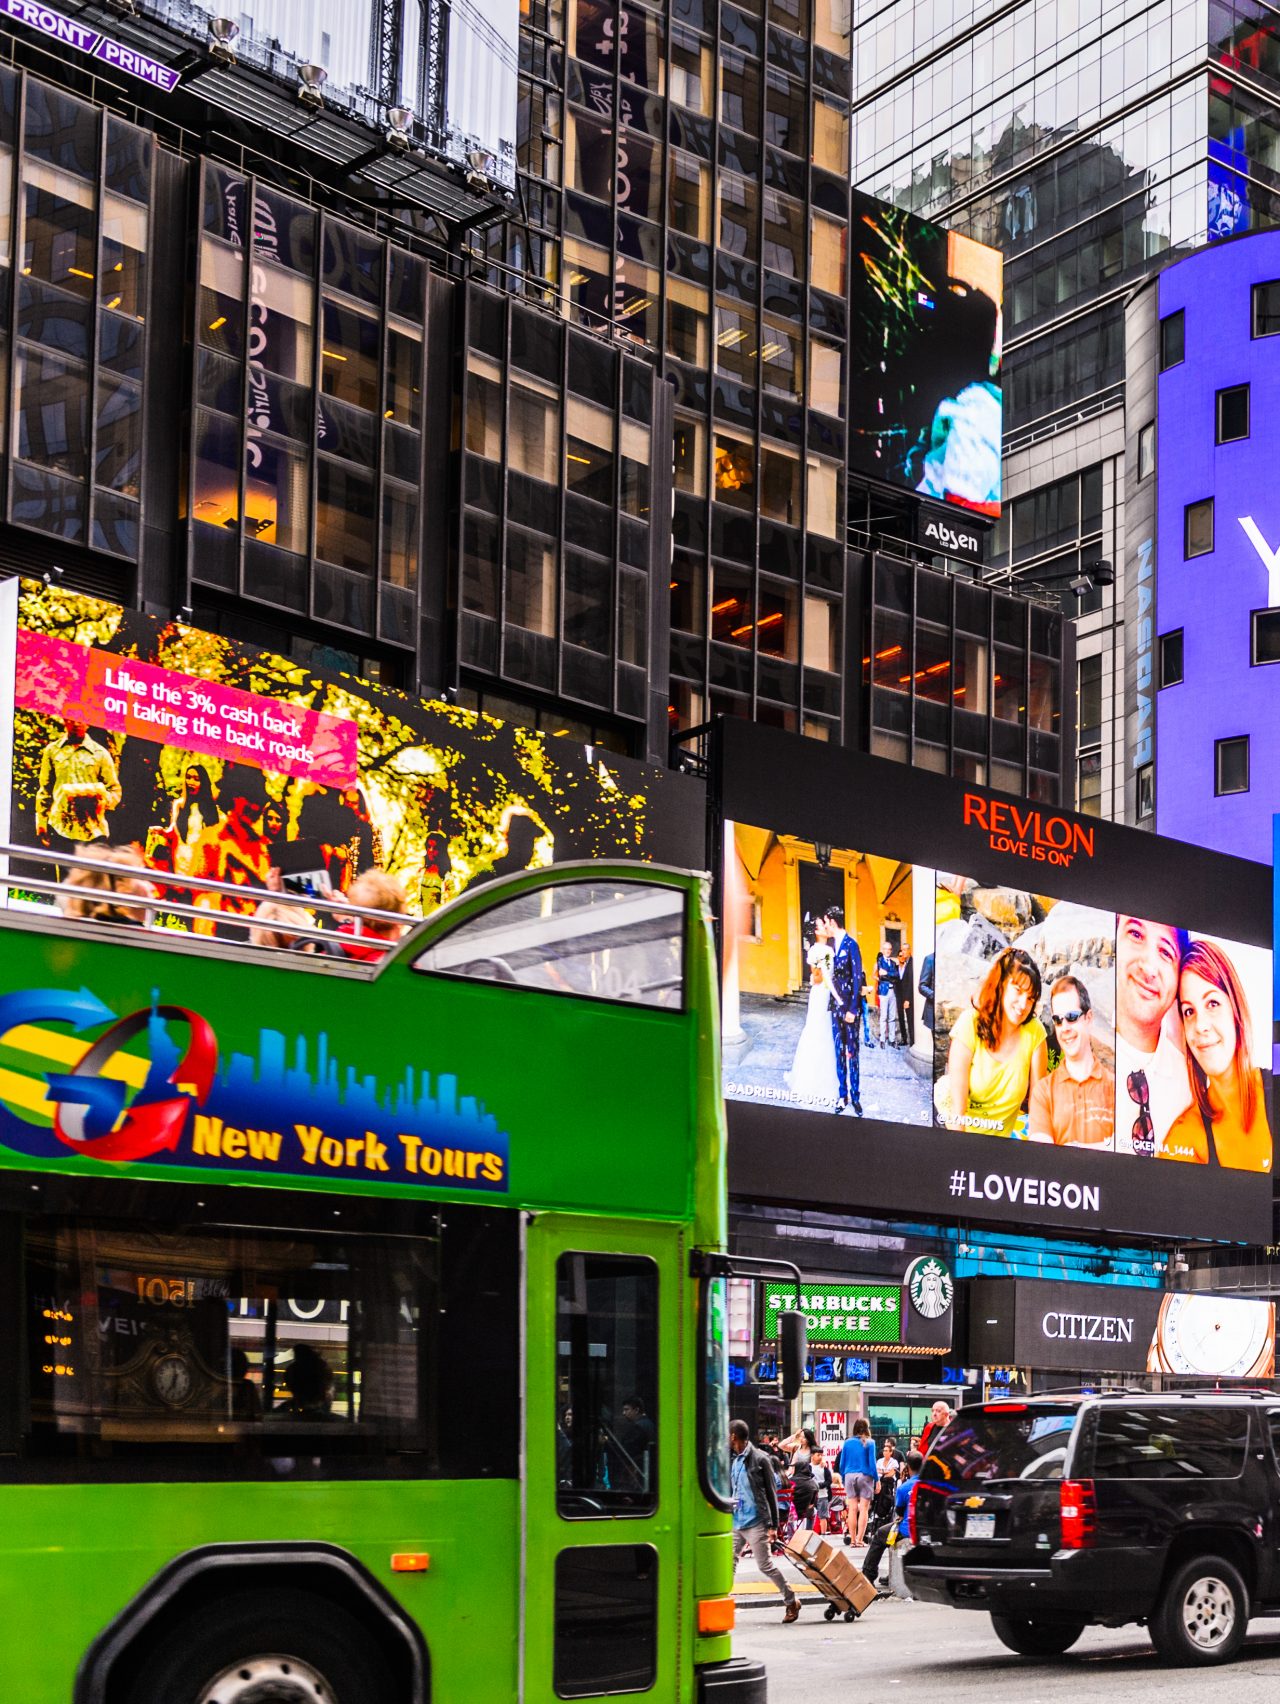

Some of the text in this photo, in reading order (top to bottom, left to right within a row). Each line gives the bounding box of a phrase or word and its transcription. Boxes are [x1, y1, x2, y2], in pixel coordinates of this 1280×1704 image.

[7, 0, 171, 88] FRONT PRIME
[925, 522, 978, 552] Absen
[105, 668, 302, 739] Like the 3% cash back
[104, 697, 315, 763] on taking the back roads
[963, 793, 1094, 858] REVLON
[990, 834, 1029, 857] LOVE
[1032, 845, 1046, 861] IS
[192, 1114, 504, 1182] New York Tours
[949, 1169, 1100, 1211] #LOVEISON
[768, 1294, 897, 1312] STARBUCKS
[806, 1315, 871, 1331] OFFEE
[1042, 1311, 1134, 1343] CITIZEN
[821, 1412, 845, 1424] ATM
[821, 1430, 845, 1441] Drink
[822, 1446, 842, 1457] Cand
